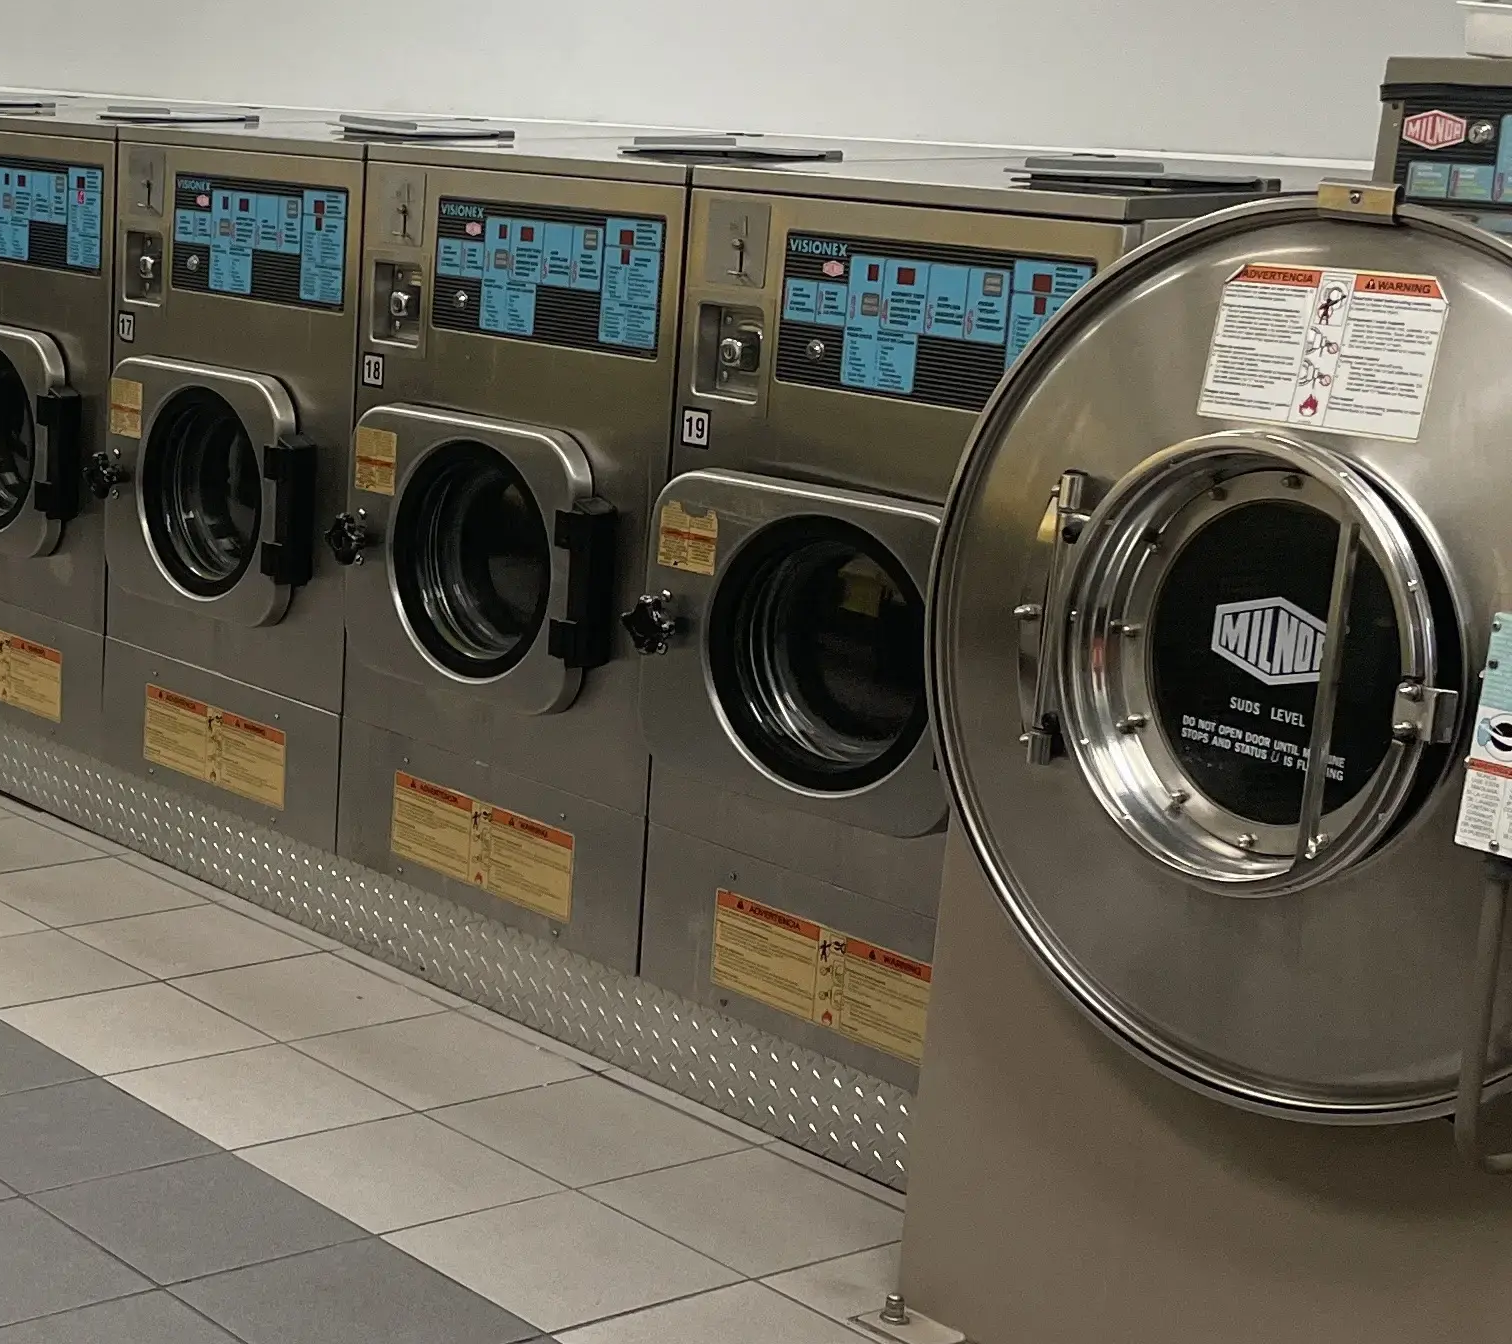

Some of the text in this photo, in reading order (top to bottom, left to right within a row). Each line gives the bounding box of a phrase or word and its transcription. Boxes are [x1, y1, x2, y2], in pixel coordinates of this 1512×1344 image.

[1406, 115, 1462, 145] MILNOR
[440, 203, 485, 219] VISIONEX
[790, 238, 849, 257] VISIONEX
[1241, 269, 1313, 284] ADVERTENCIA
[1377, 281, 1431, 294] WARNING
[120, 318, 132, 335] 17
[365, 361, 381, 381] 18
[685, 416, 706, 440] 19
[1230, 696, 1305, 728] SUDS LEVEL
[1182, 715, 1346, 769] DO NOT OPEN DOOR UNTIL MINE
[1181, 727, 1209, 744] STOPS
[1211, 735, 1231, 750] AND
[1234, 742, 1268, 761] STATUS
[1283, 755, 1293, 768] IS
[1296, 759, 1344, 782] FLING
